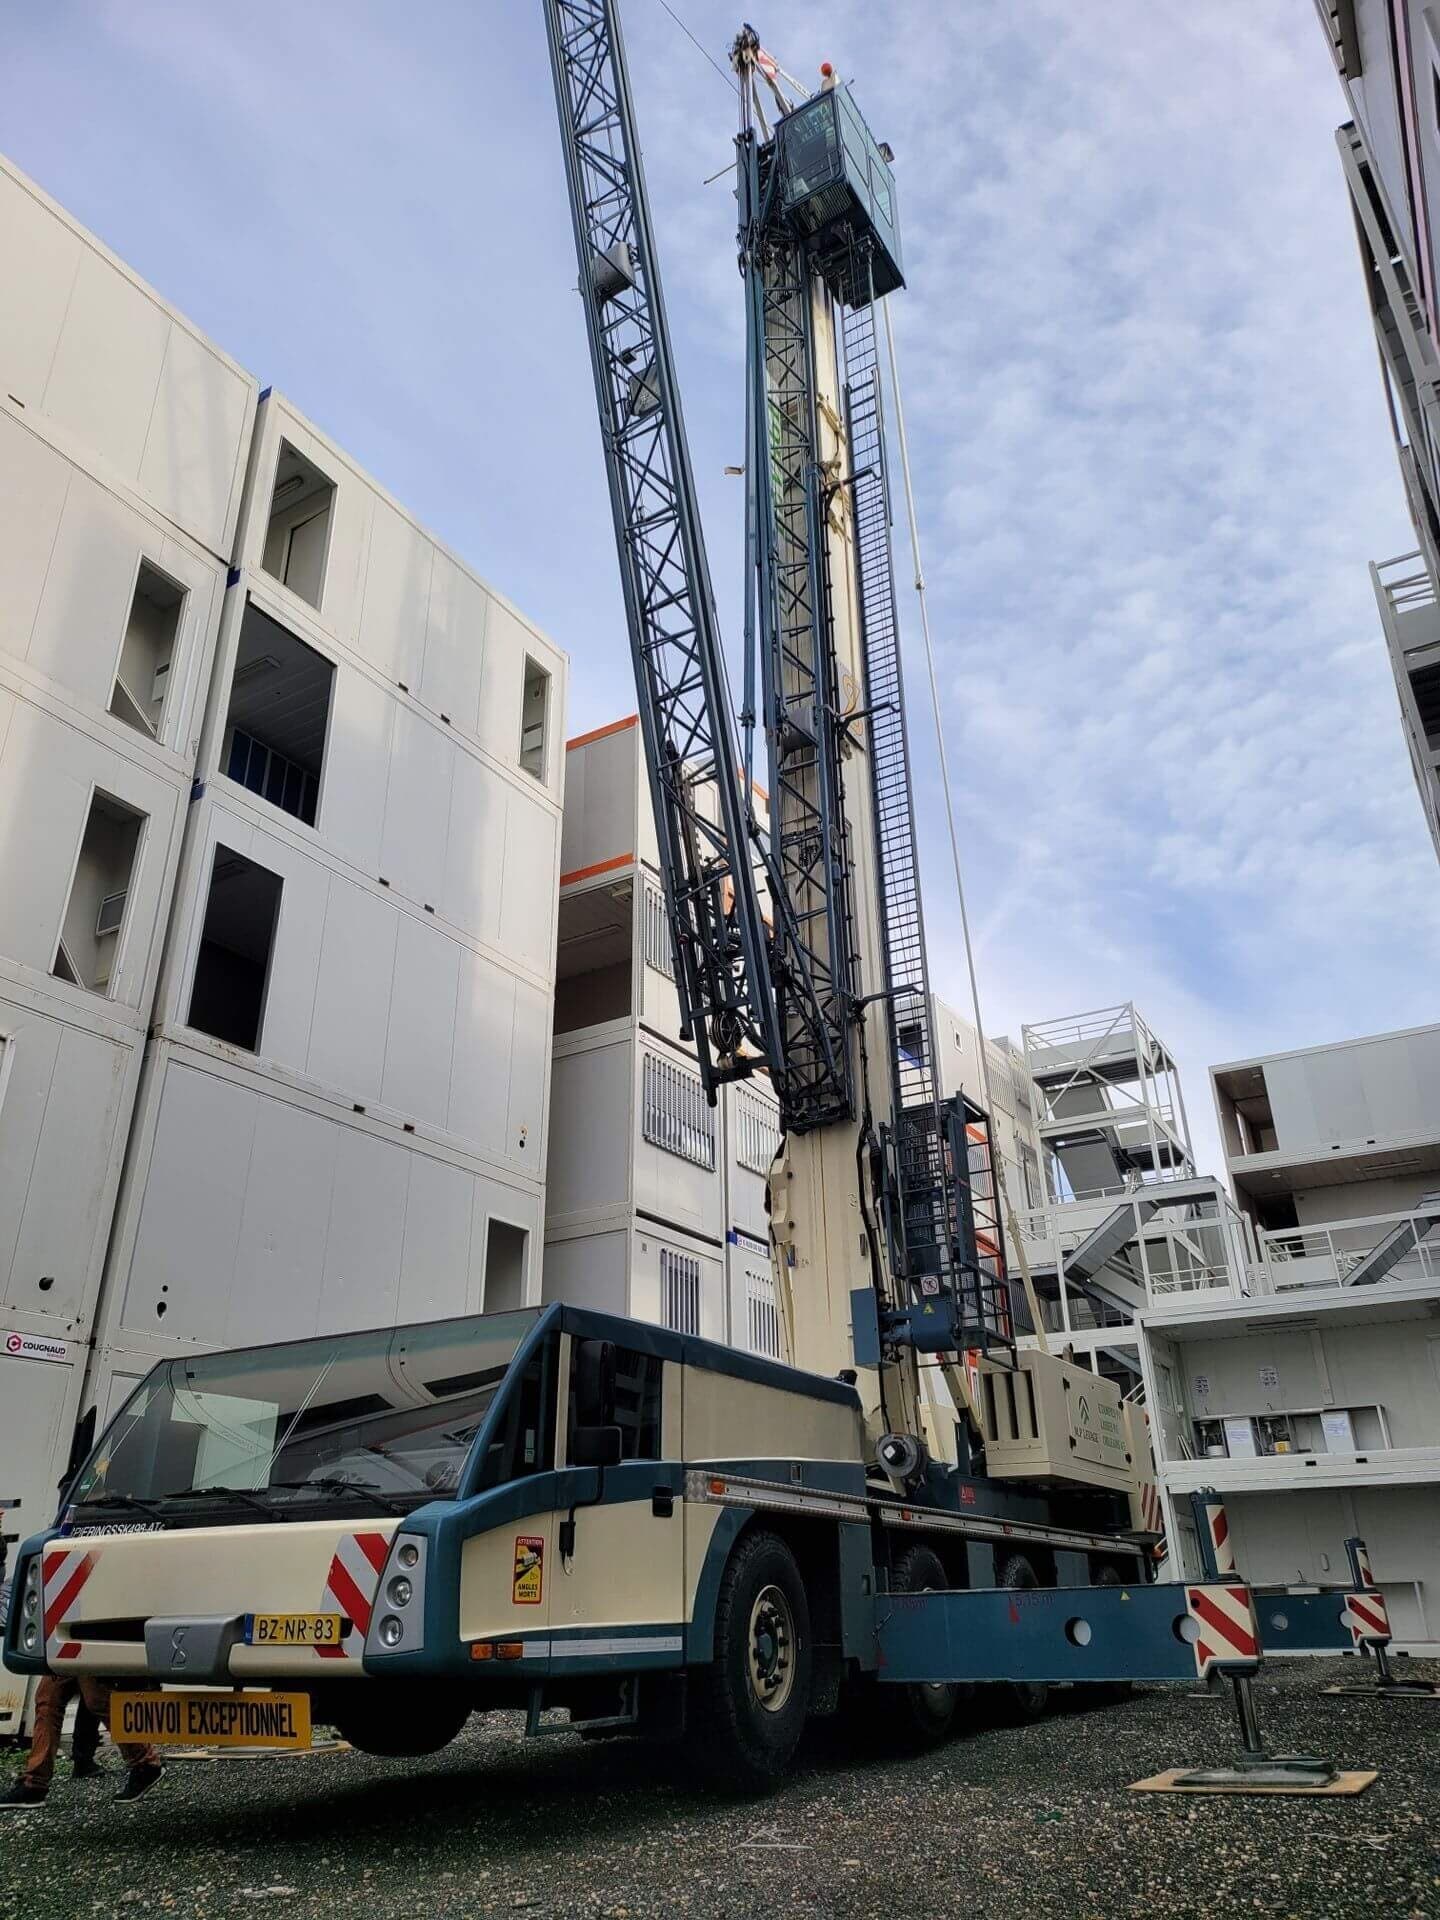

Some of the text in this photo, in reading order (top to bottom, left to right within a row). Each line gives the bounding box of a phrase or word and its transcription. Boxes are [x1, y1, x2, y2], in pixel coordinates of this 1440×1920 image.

[23, 1342, 66, 1354] COUGNAUD
[259, 1619, 333, 1640] BZ-NR-83
[123, 1701, 297, 1738] CONVOI EXCEPTIONNEL
